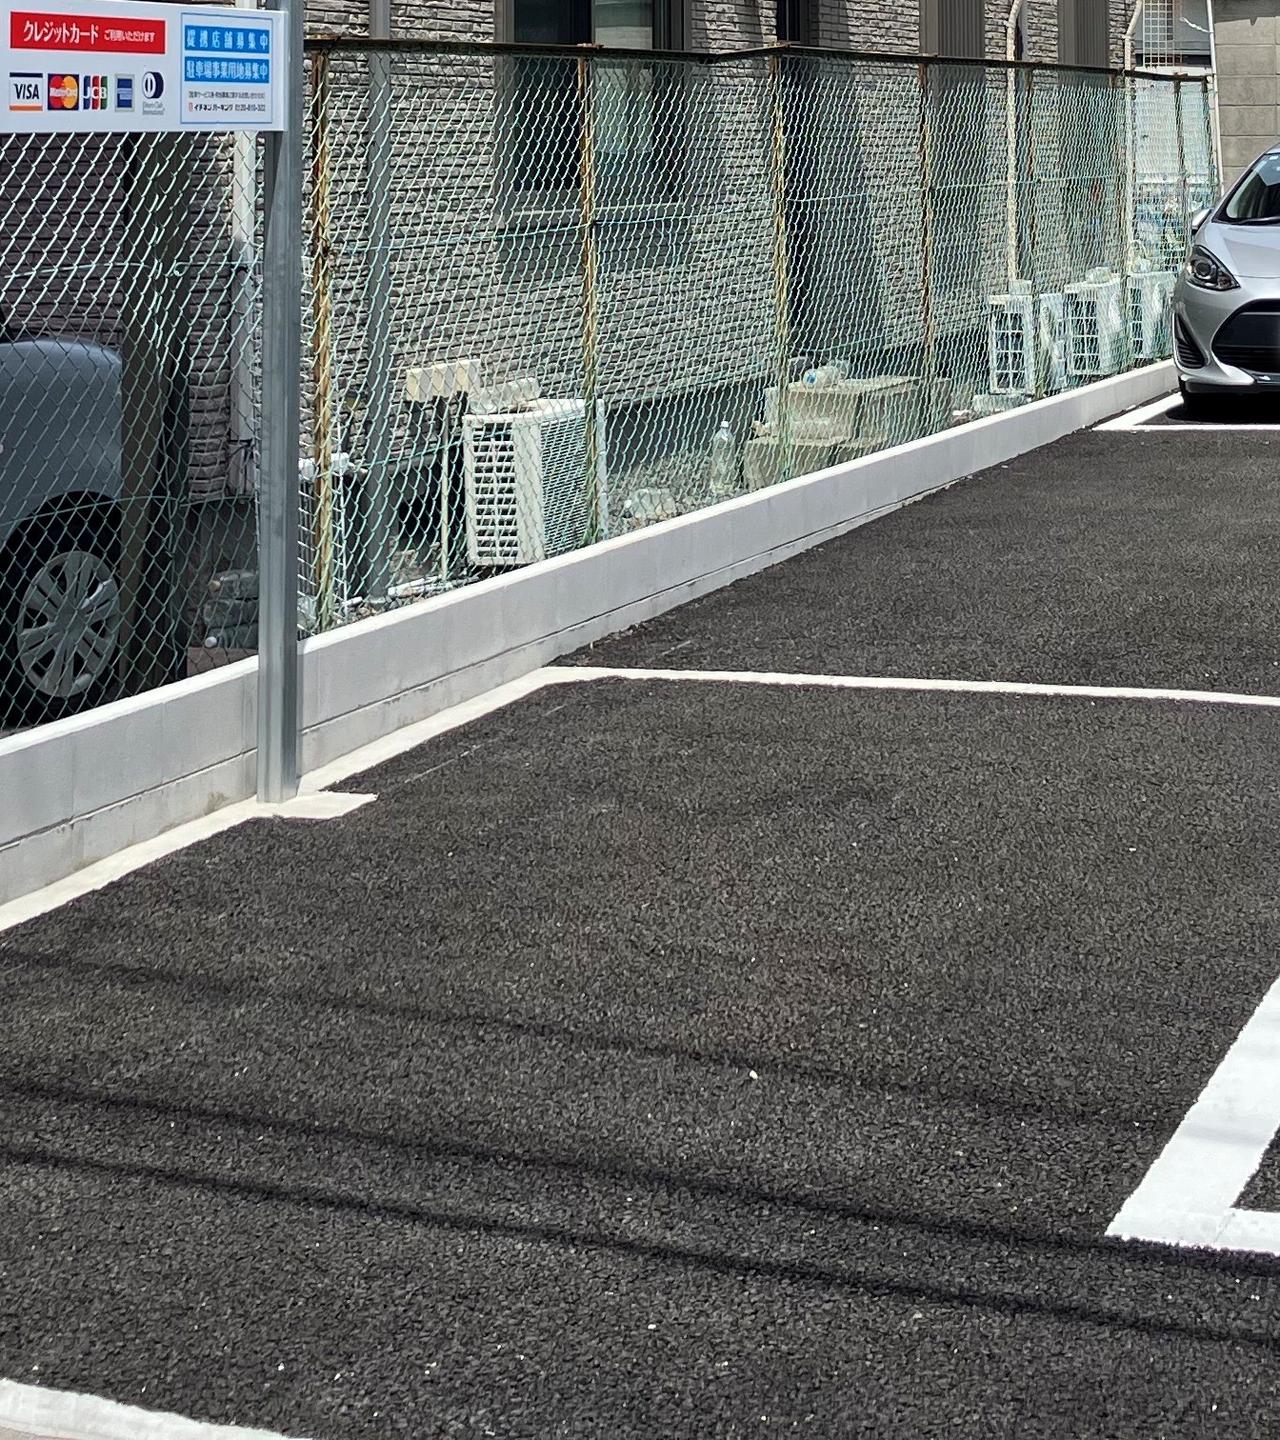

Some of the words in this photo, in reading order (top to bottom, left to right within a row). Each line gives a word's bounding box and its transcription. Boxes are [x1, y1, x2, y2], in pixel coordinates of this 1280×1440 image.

[23, 19, 99, 45] クレジットカード
[13, 83, 40, 100] VISA
[83, 86, 108, 99] JCB
